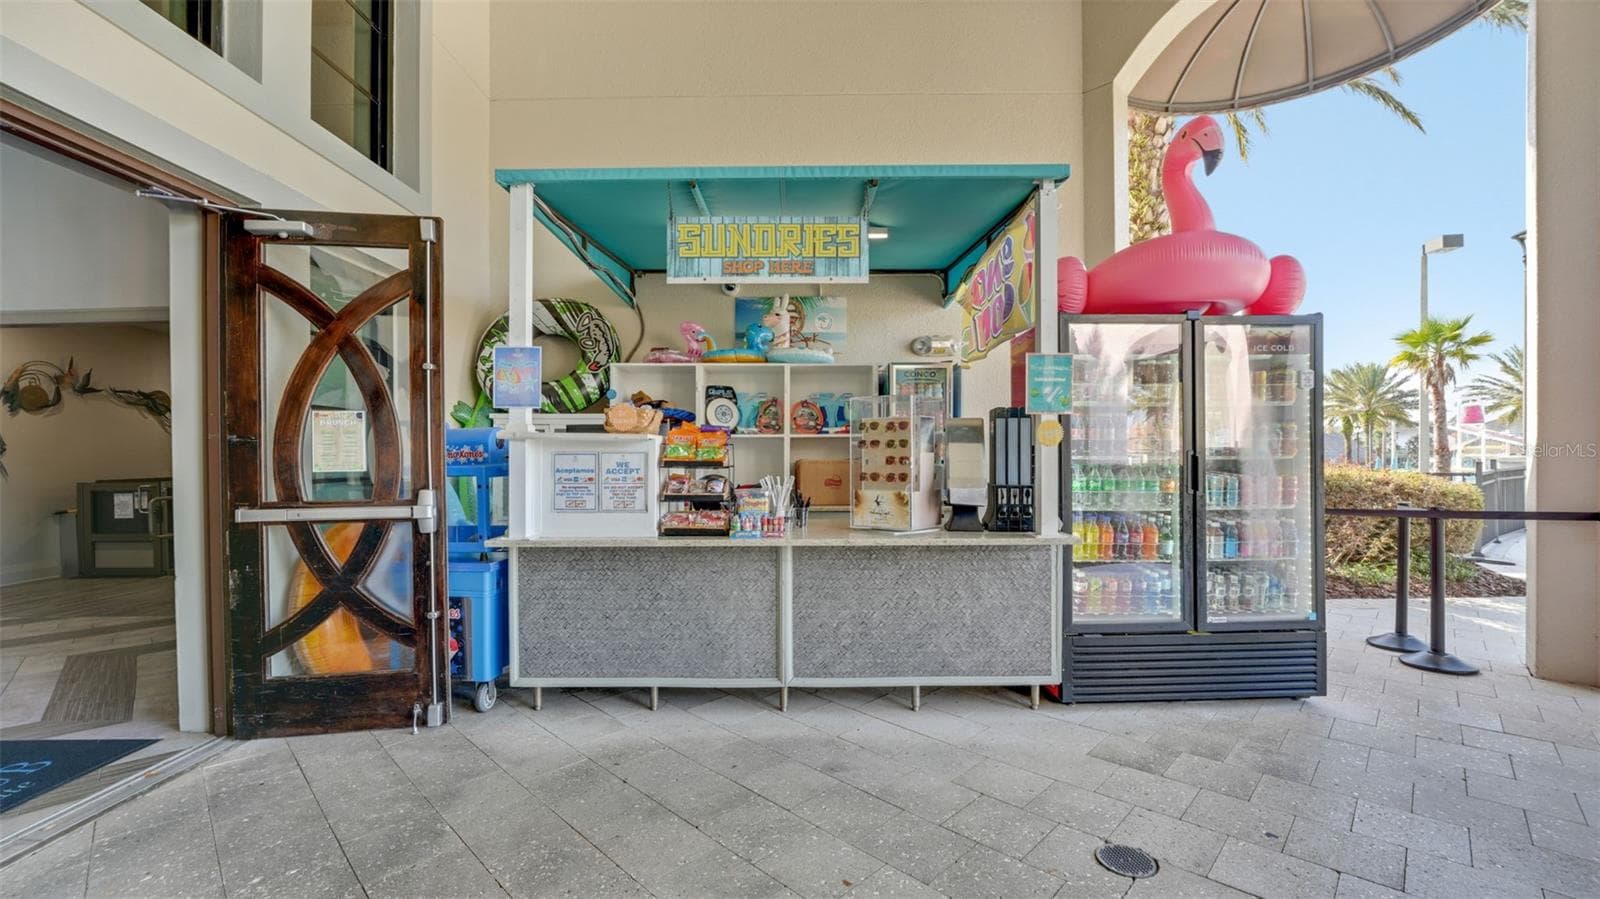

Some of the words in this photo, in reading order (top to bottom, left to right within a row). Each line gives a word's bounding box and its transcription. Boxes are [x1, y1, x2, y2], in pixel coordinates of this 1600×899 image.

[677, 223, 861, 258] SUNDRIES
[723, 260, 764, 274] SHOP
[769, 260, 815, 274] HERE
[1253, 344, 1269, 352] ICE
[1270, 344, 1295, 352] COLD
